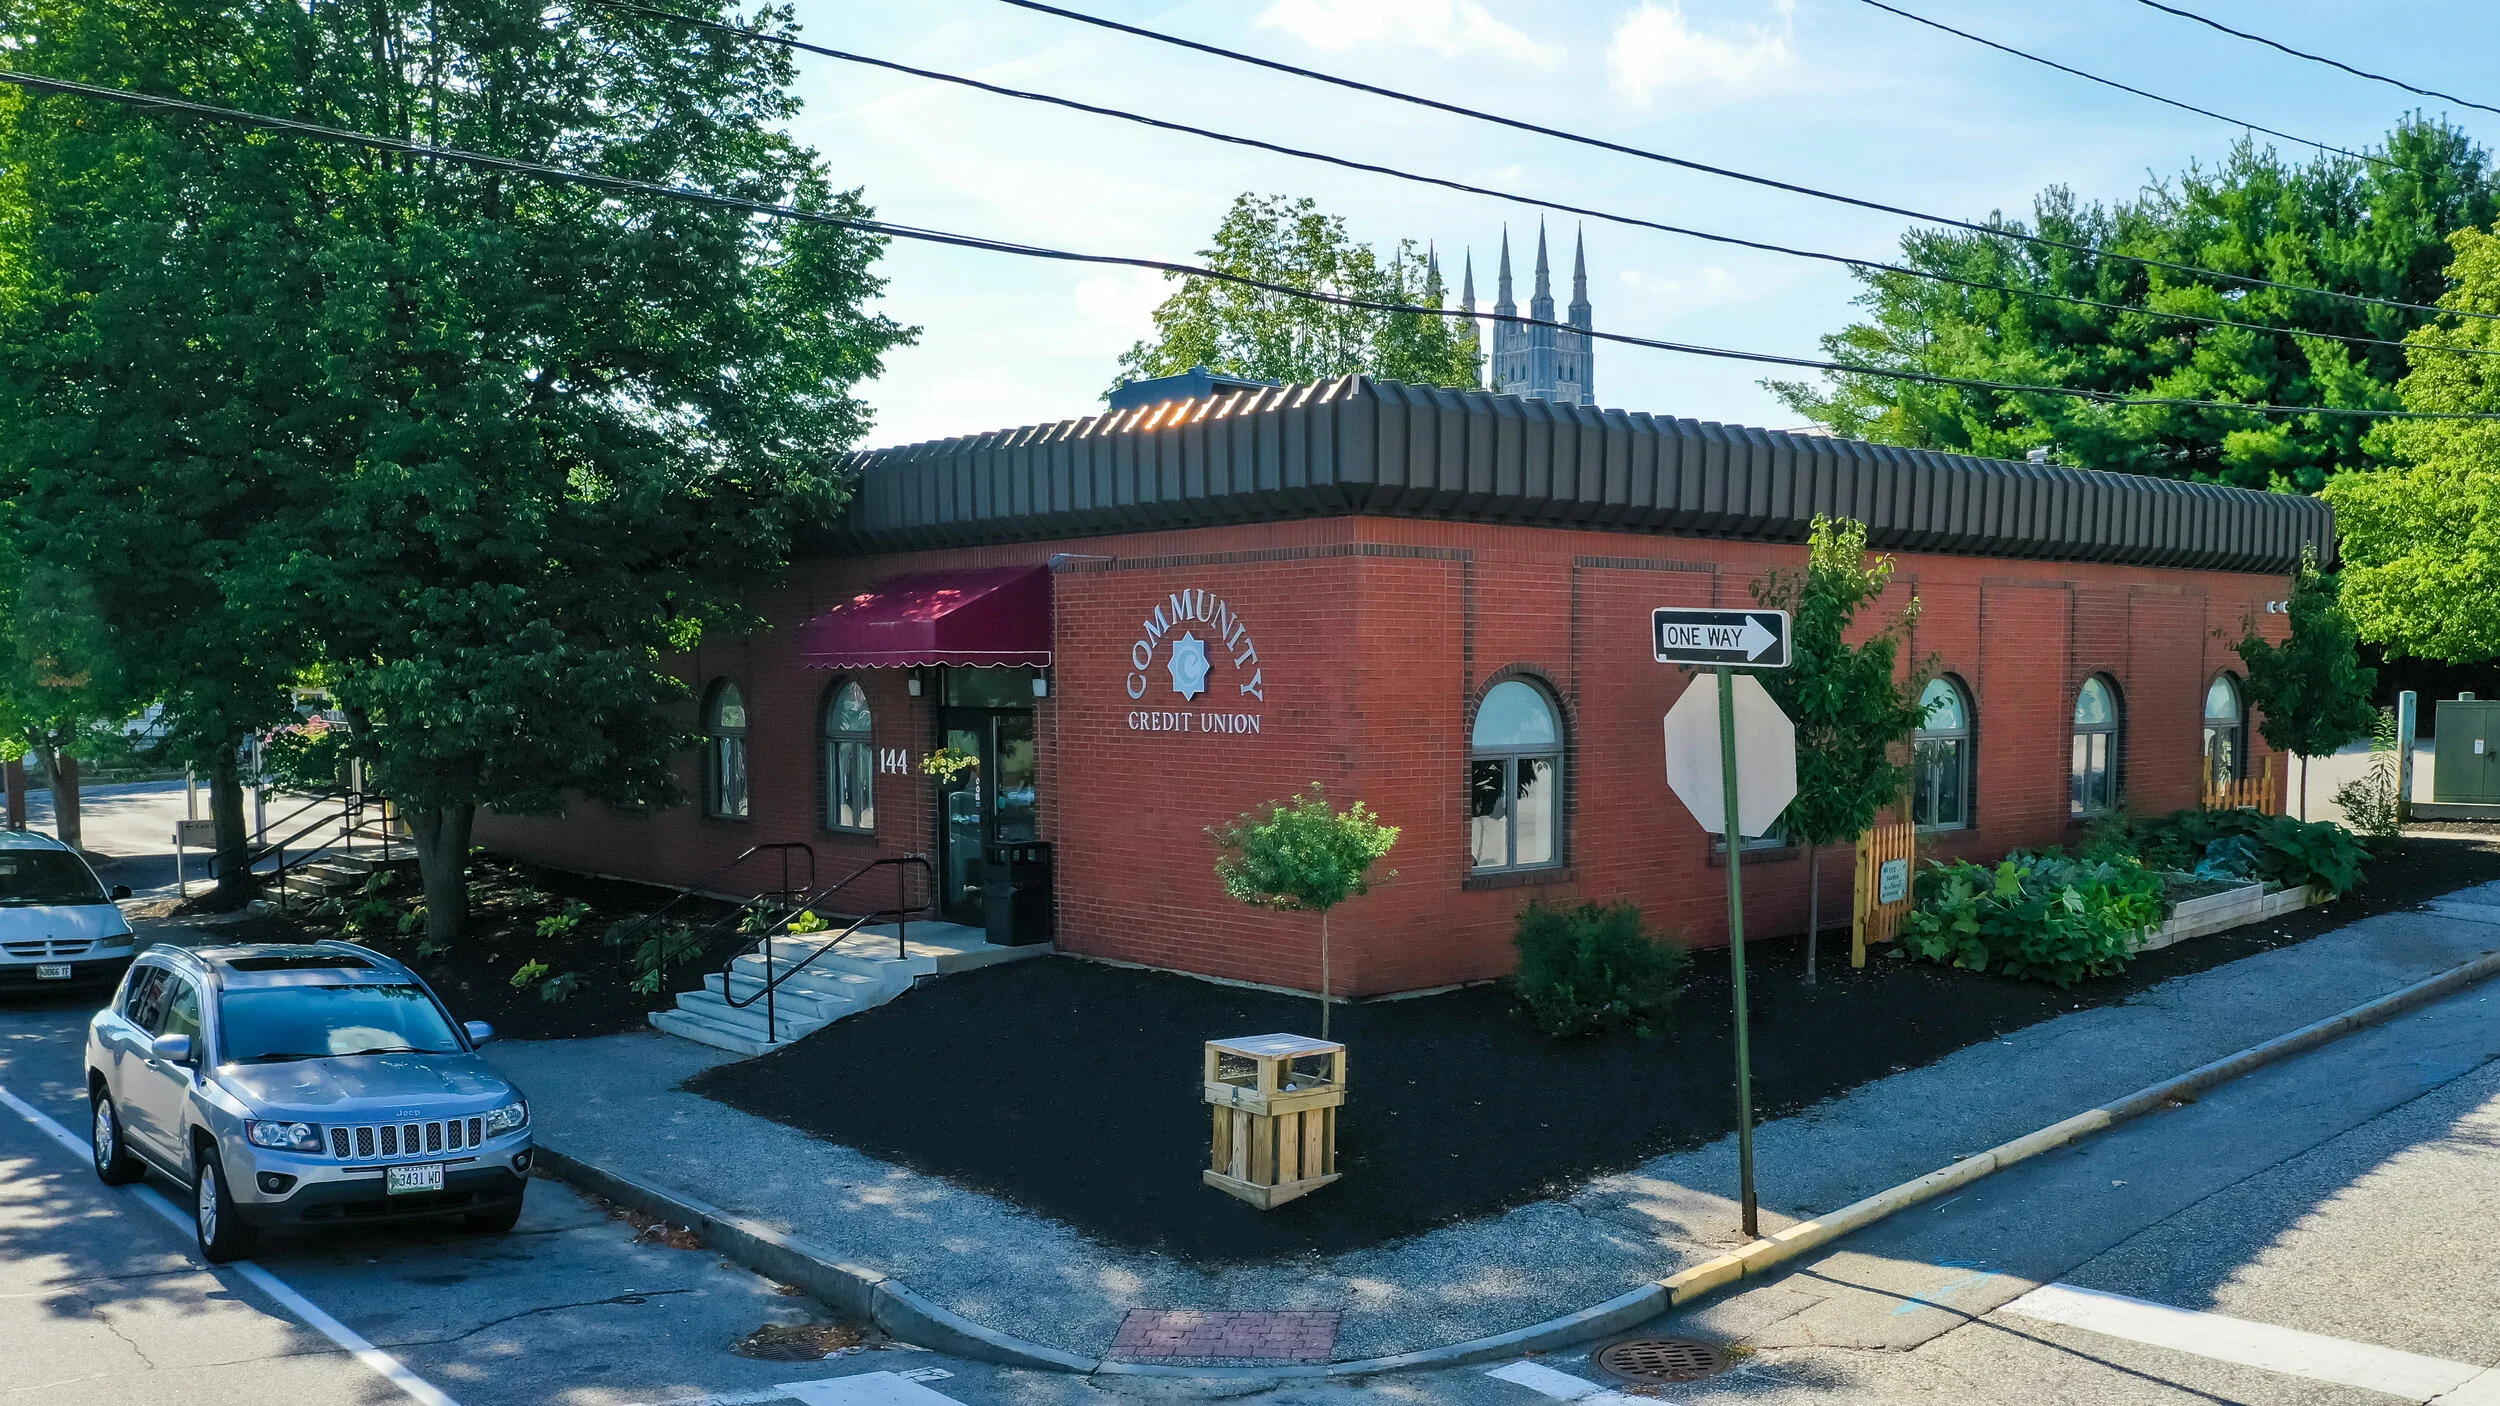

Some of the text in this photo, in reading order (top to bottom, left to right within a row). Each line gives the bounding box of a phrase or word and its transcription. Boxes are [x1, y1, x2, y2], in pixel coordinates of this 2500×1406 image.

[1126, 588, 1263, 702] COMMUNITY
[1667, 626, 1743, 648] ONE WAY
[1128, 711, 1261, 734] CREDIT UNION
[880, 747, 908, 775] 144
[396, 1109, 421, 1117] Jeep
[399, 1170, 441, 1187] 3431 WD
